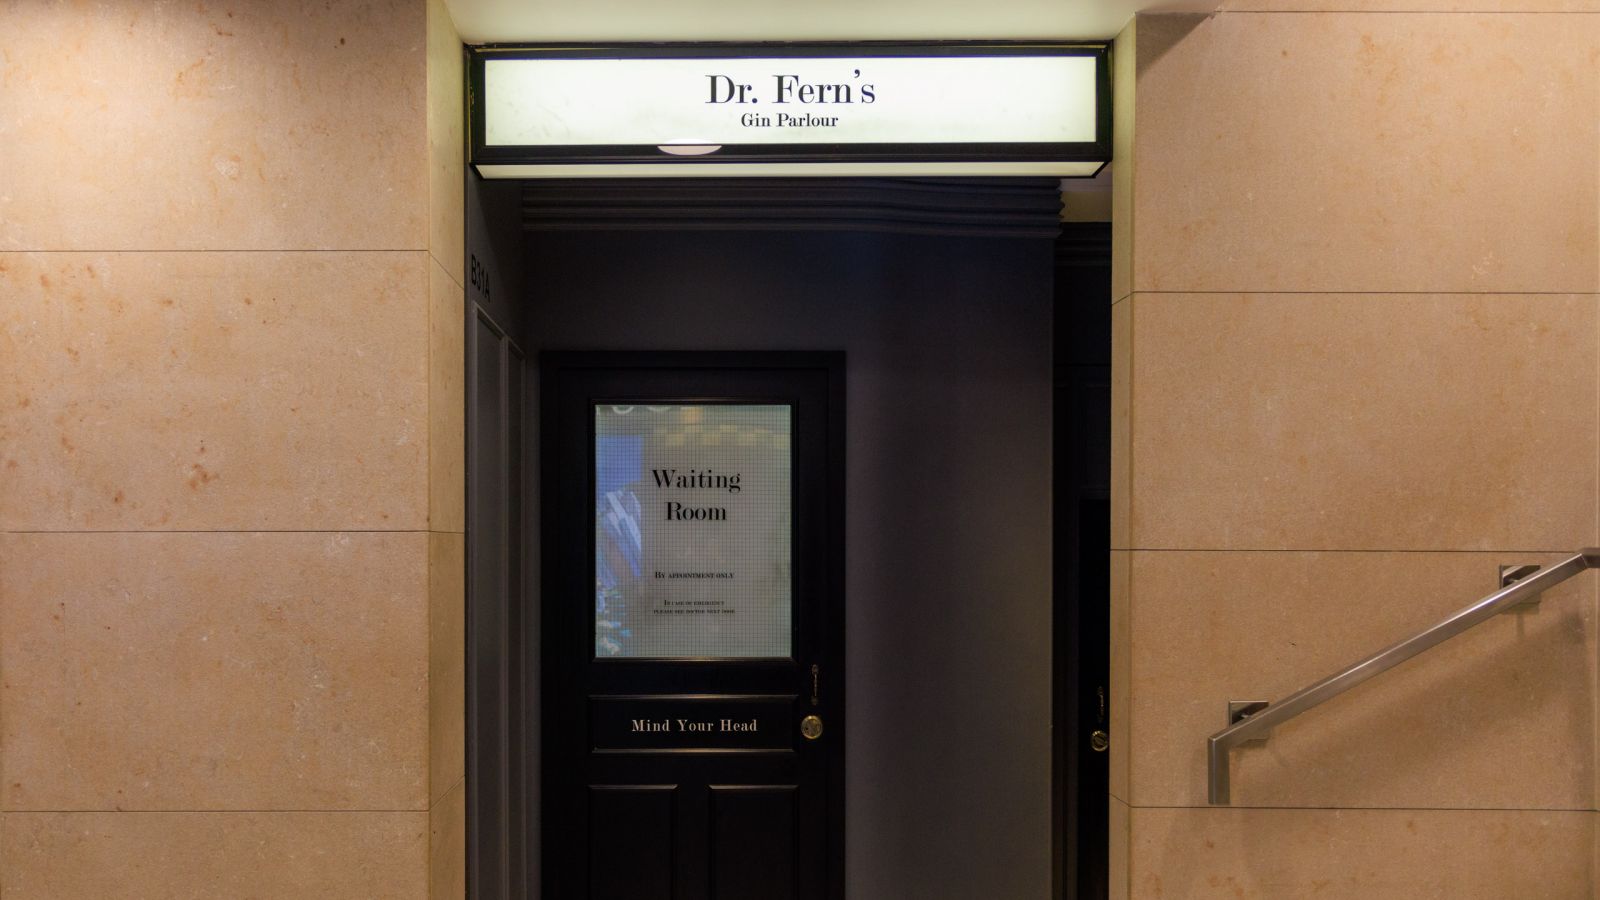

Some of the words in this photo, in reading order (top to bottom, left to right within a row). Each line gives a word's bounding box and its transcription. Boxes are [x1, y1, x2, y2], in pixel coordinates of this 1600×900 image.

[705, 75, 758, 104] Dr.
[741, 113, 771, 127] Gin
[776, 113, 838, 127] Parlour
[471, 253, 491, 303] B31A
[652, 469, 741, 493] Waiting
[664, 501, 727, 521] Room
[632, 719, 670, 732] Mind
[678, 719, 714, 732] Your
[720, 719, 757, 732] Head
